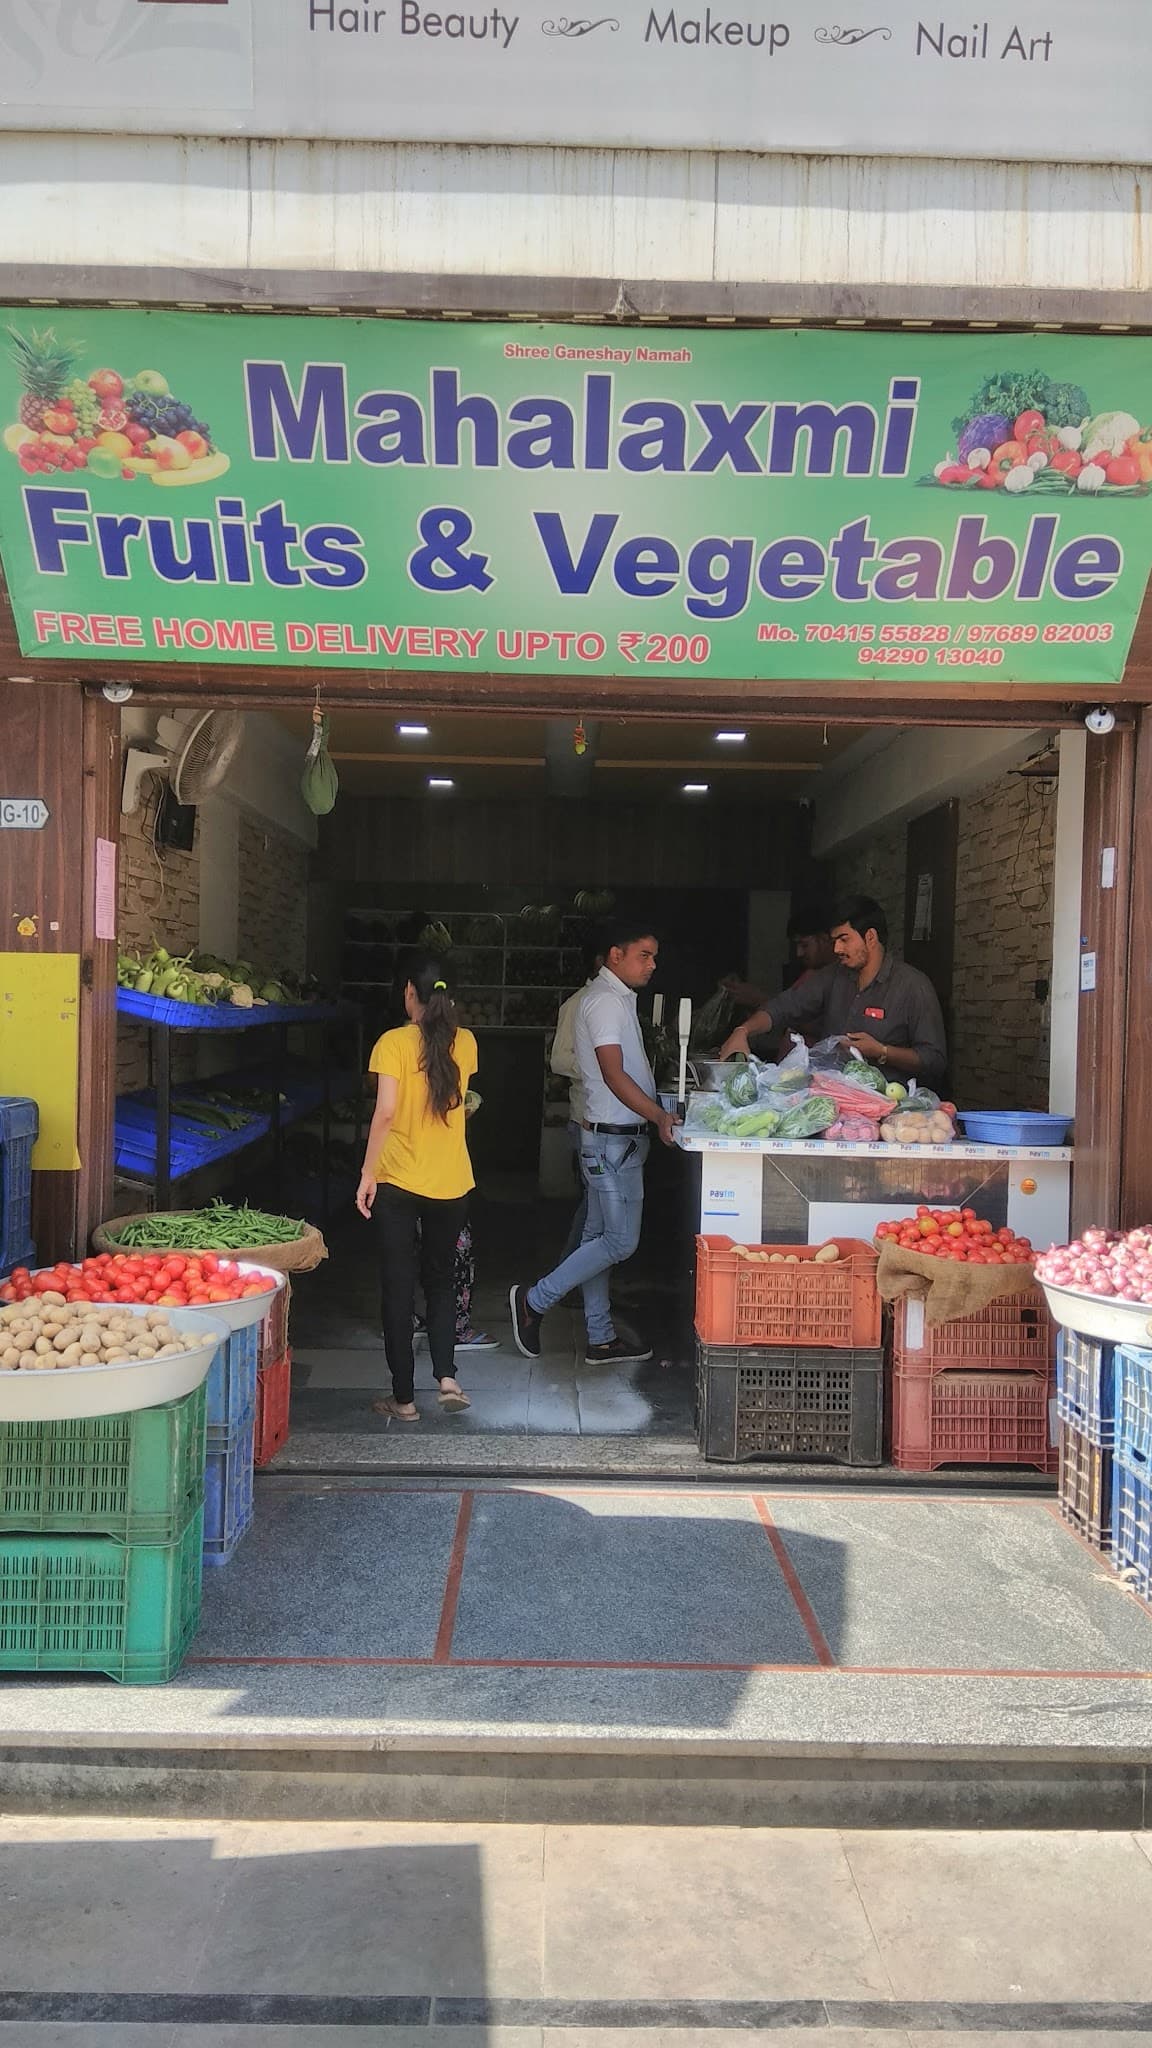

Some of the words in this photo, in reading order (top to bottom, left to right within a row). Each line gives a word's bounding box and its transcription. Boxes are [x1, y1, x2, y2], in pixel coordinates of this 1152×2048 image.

[309, 0, 386, 33] Hair
[401, 0, 519, 48] Beauty
[645, 8, 790, 55] Makeup
[916, 21, 988, 58] Nail
[1001, 25, 1053, 61] Art
[504, 344, 550, 358] Shree
[555, 345, 632, 363] Ganeshay
[636, 348, 691, 362] Namah
[244, 361, 920, 477] Mahalaxmi
[22, 486, 367, 589] Fruits
[408, 506, 496, 593] &
[533, 512, 1122, 620] Vegetable
[33, 610, 145, 647] FREE
[153, 617, 277, 651] HOME
[286, 623, 486, 658] DELIVERY
[497, 630, 605, 661] UPTO
[618, 632, 710, 664] ₹200
[758, 624, 799, 642] Mo.
[805, 624, 874, 642] 70415
[879, 624, 949, 642] 55828
[953, 624, 964, 643] /
[967, 624, 1038, 642] 97689
[1043, 623, 1114, 642] 82003
[858, 647, 928, 665] 94290
[934, 648, 1004, 665] 13040
[3, 804, 40, 823] G-10
